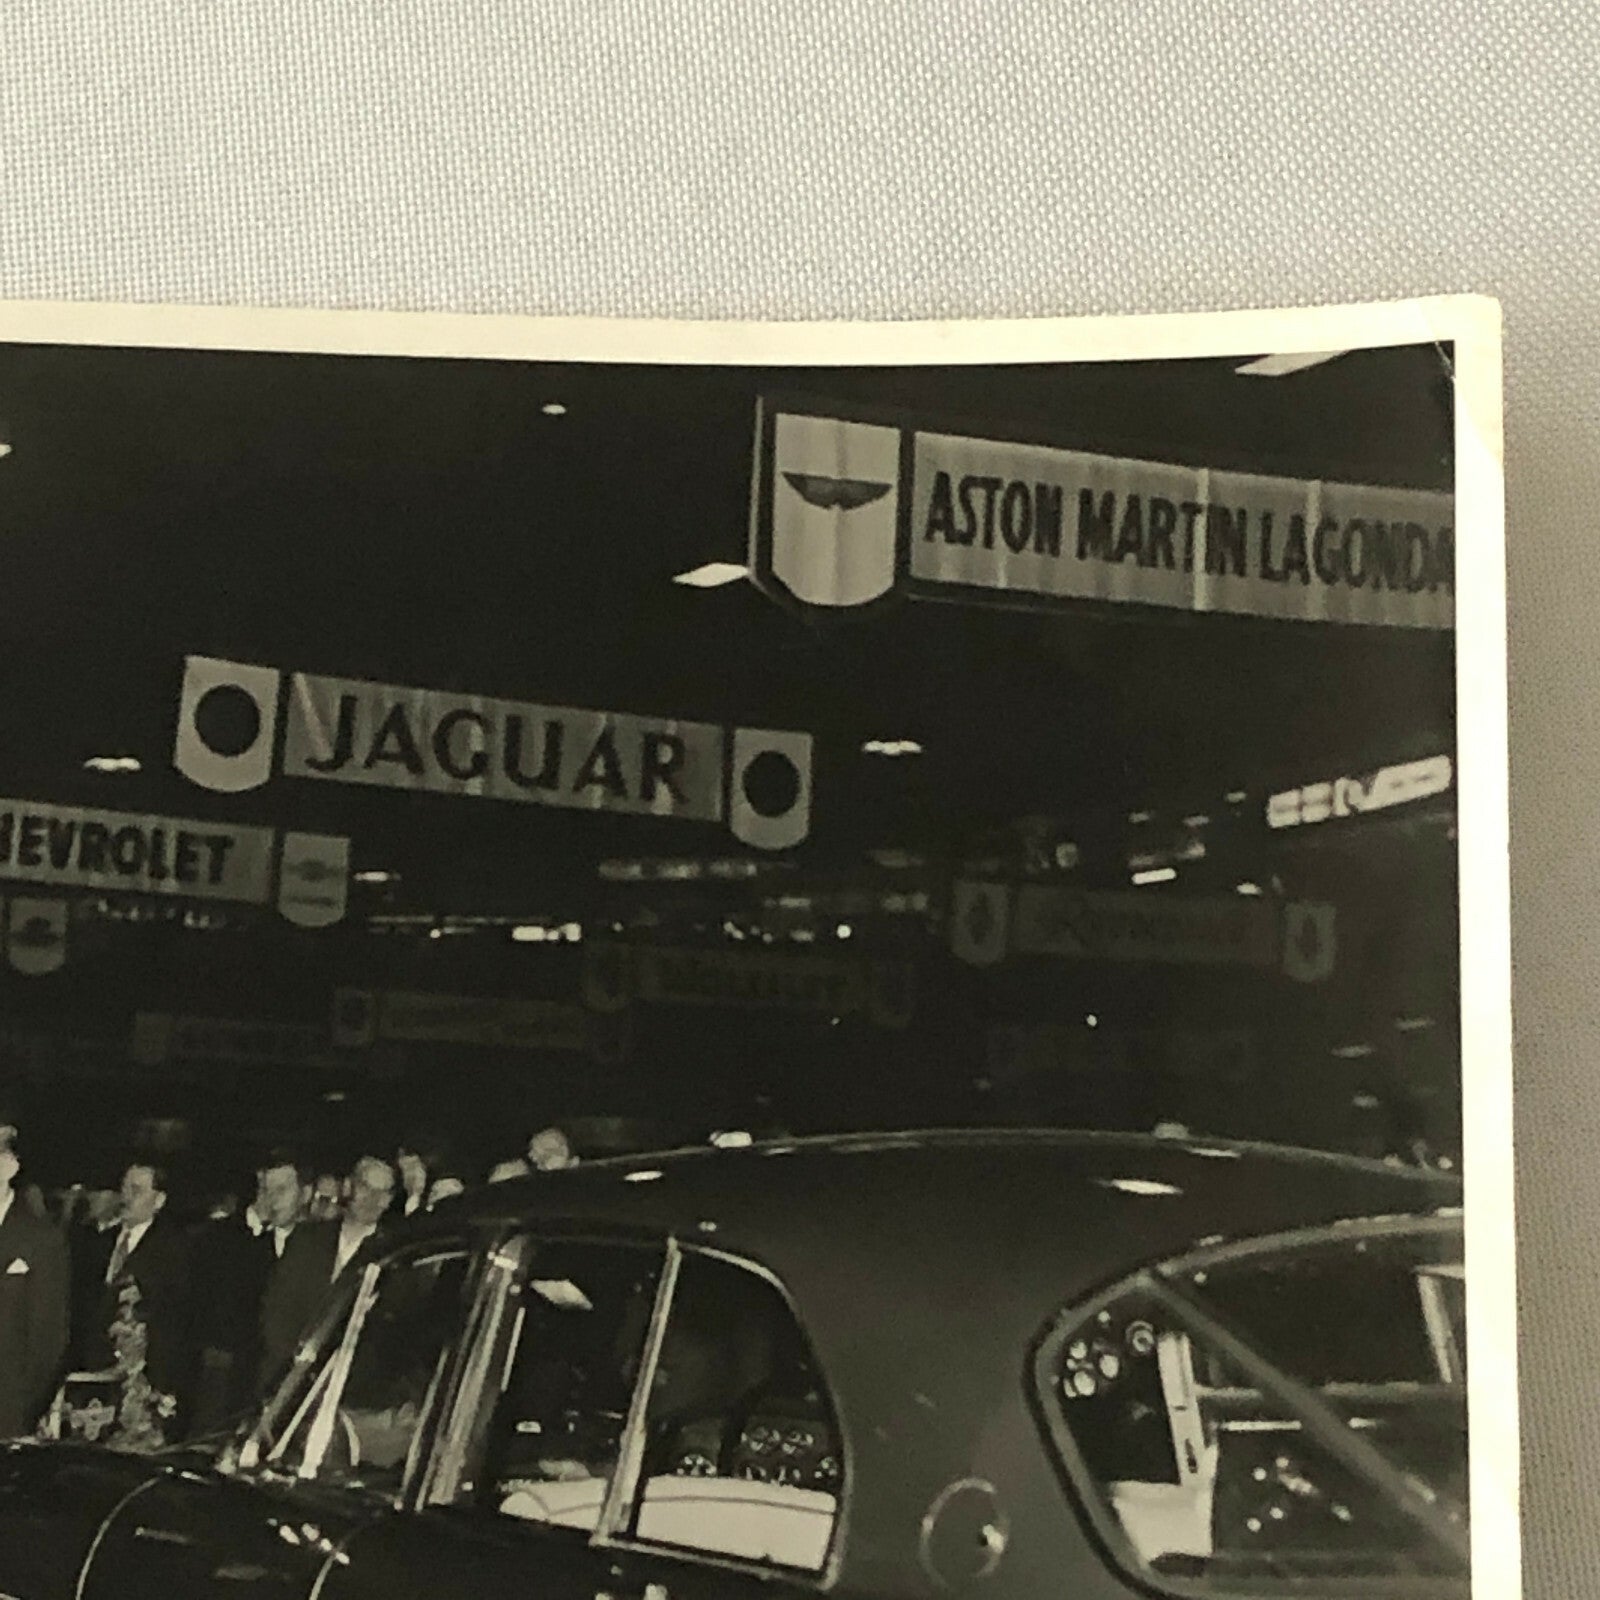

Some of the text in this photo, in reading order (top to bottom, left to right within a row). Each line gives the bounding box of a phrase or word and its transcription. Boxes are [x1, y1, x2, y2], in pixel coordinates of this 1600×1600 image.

[923, 470, 1063, 558] ASTON
[1076, 487, 1247, 578] MARTIN
[304, 694, 686, 802] JAGUAR
